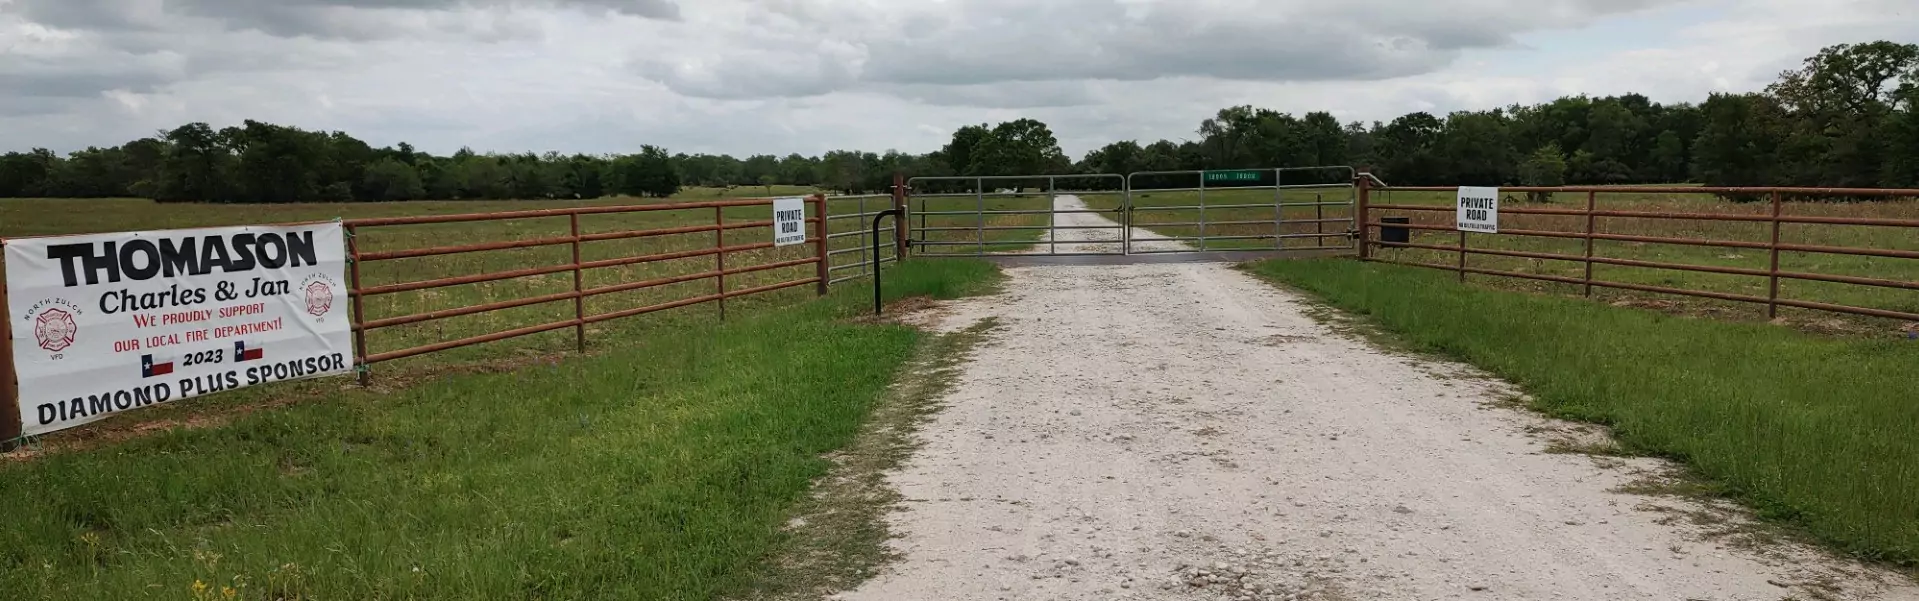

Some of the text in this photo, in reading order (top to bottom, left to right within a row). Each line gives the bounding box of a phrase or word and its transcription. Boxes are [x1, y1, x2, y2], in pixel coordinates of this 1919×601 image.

[1461, 197, 1493, 210] PRIVATE
[776, 209, 802, 222] PRIVATE
[1466, 209, 1487, 221] ROAD
[782, 222, 798, 234] ROAD
[47, 231, 317, 287] THOMASON
[100, 277, 290, 314] Charles & Jan
[24, 297, 83, 321] NORTH ZULCH
[162, 309, 213, 326] PROUDLY
[219, 302, 264, 318] SUPPORT
[114, 316, 282, 352] OUR LOCAL FIRE DEPARTMENT!
[50, 353, 64, 361] VFD
[183, 348, 224, 366] 2023
[37, 352, 345, 425] DIAMOND PLUS SPONSOR
